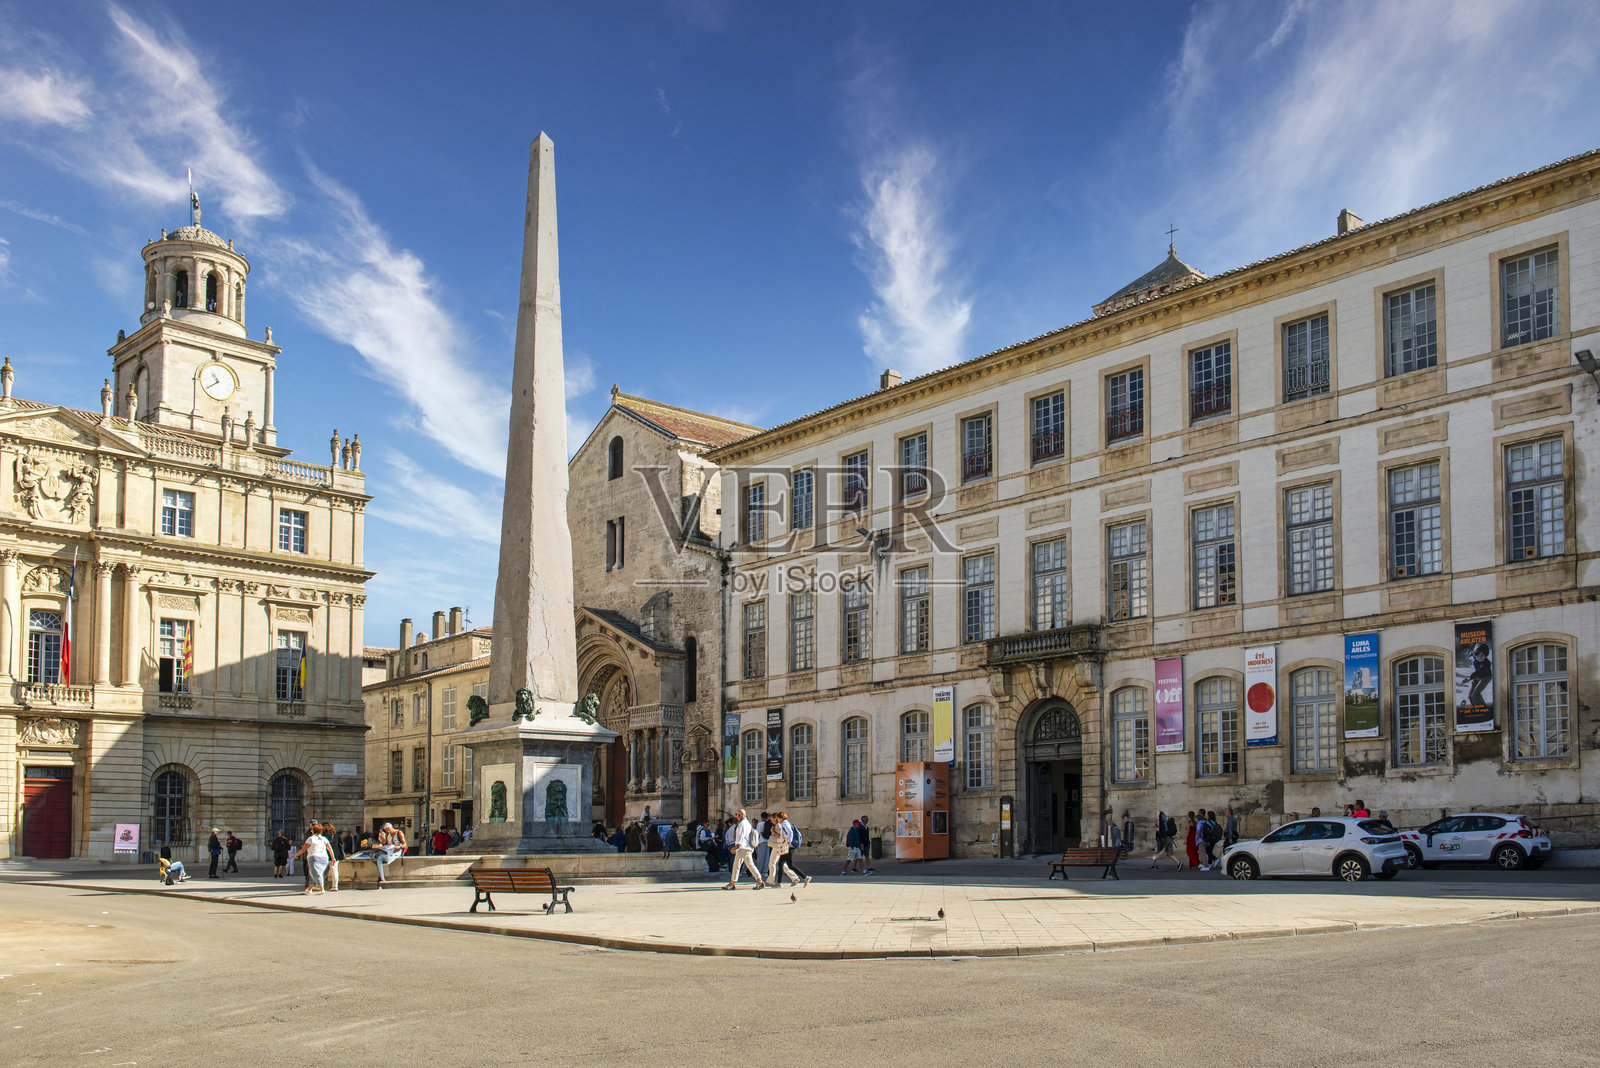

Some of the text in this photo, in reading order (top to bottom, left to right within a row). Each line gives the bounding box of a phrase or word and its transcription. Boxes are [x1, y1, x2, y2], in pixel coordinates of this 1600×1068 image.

[1460, 630, 1486, 638] MUSEON
[1460, 636, 1487, 645] ARLATEN
[1255, 651, 1265, 659] ÉTÉ
